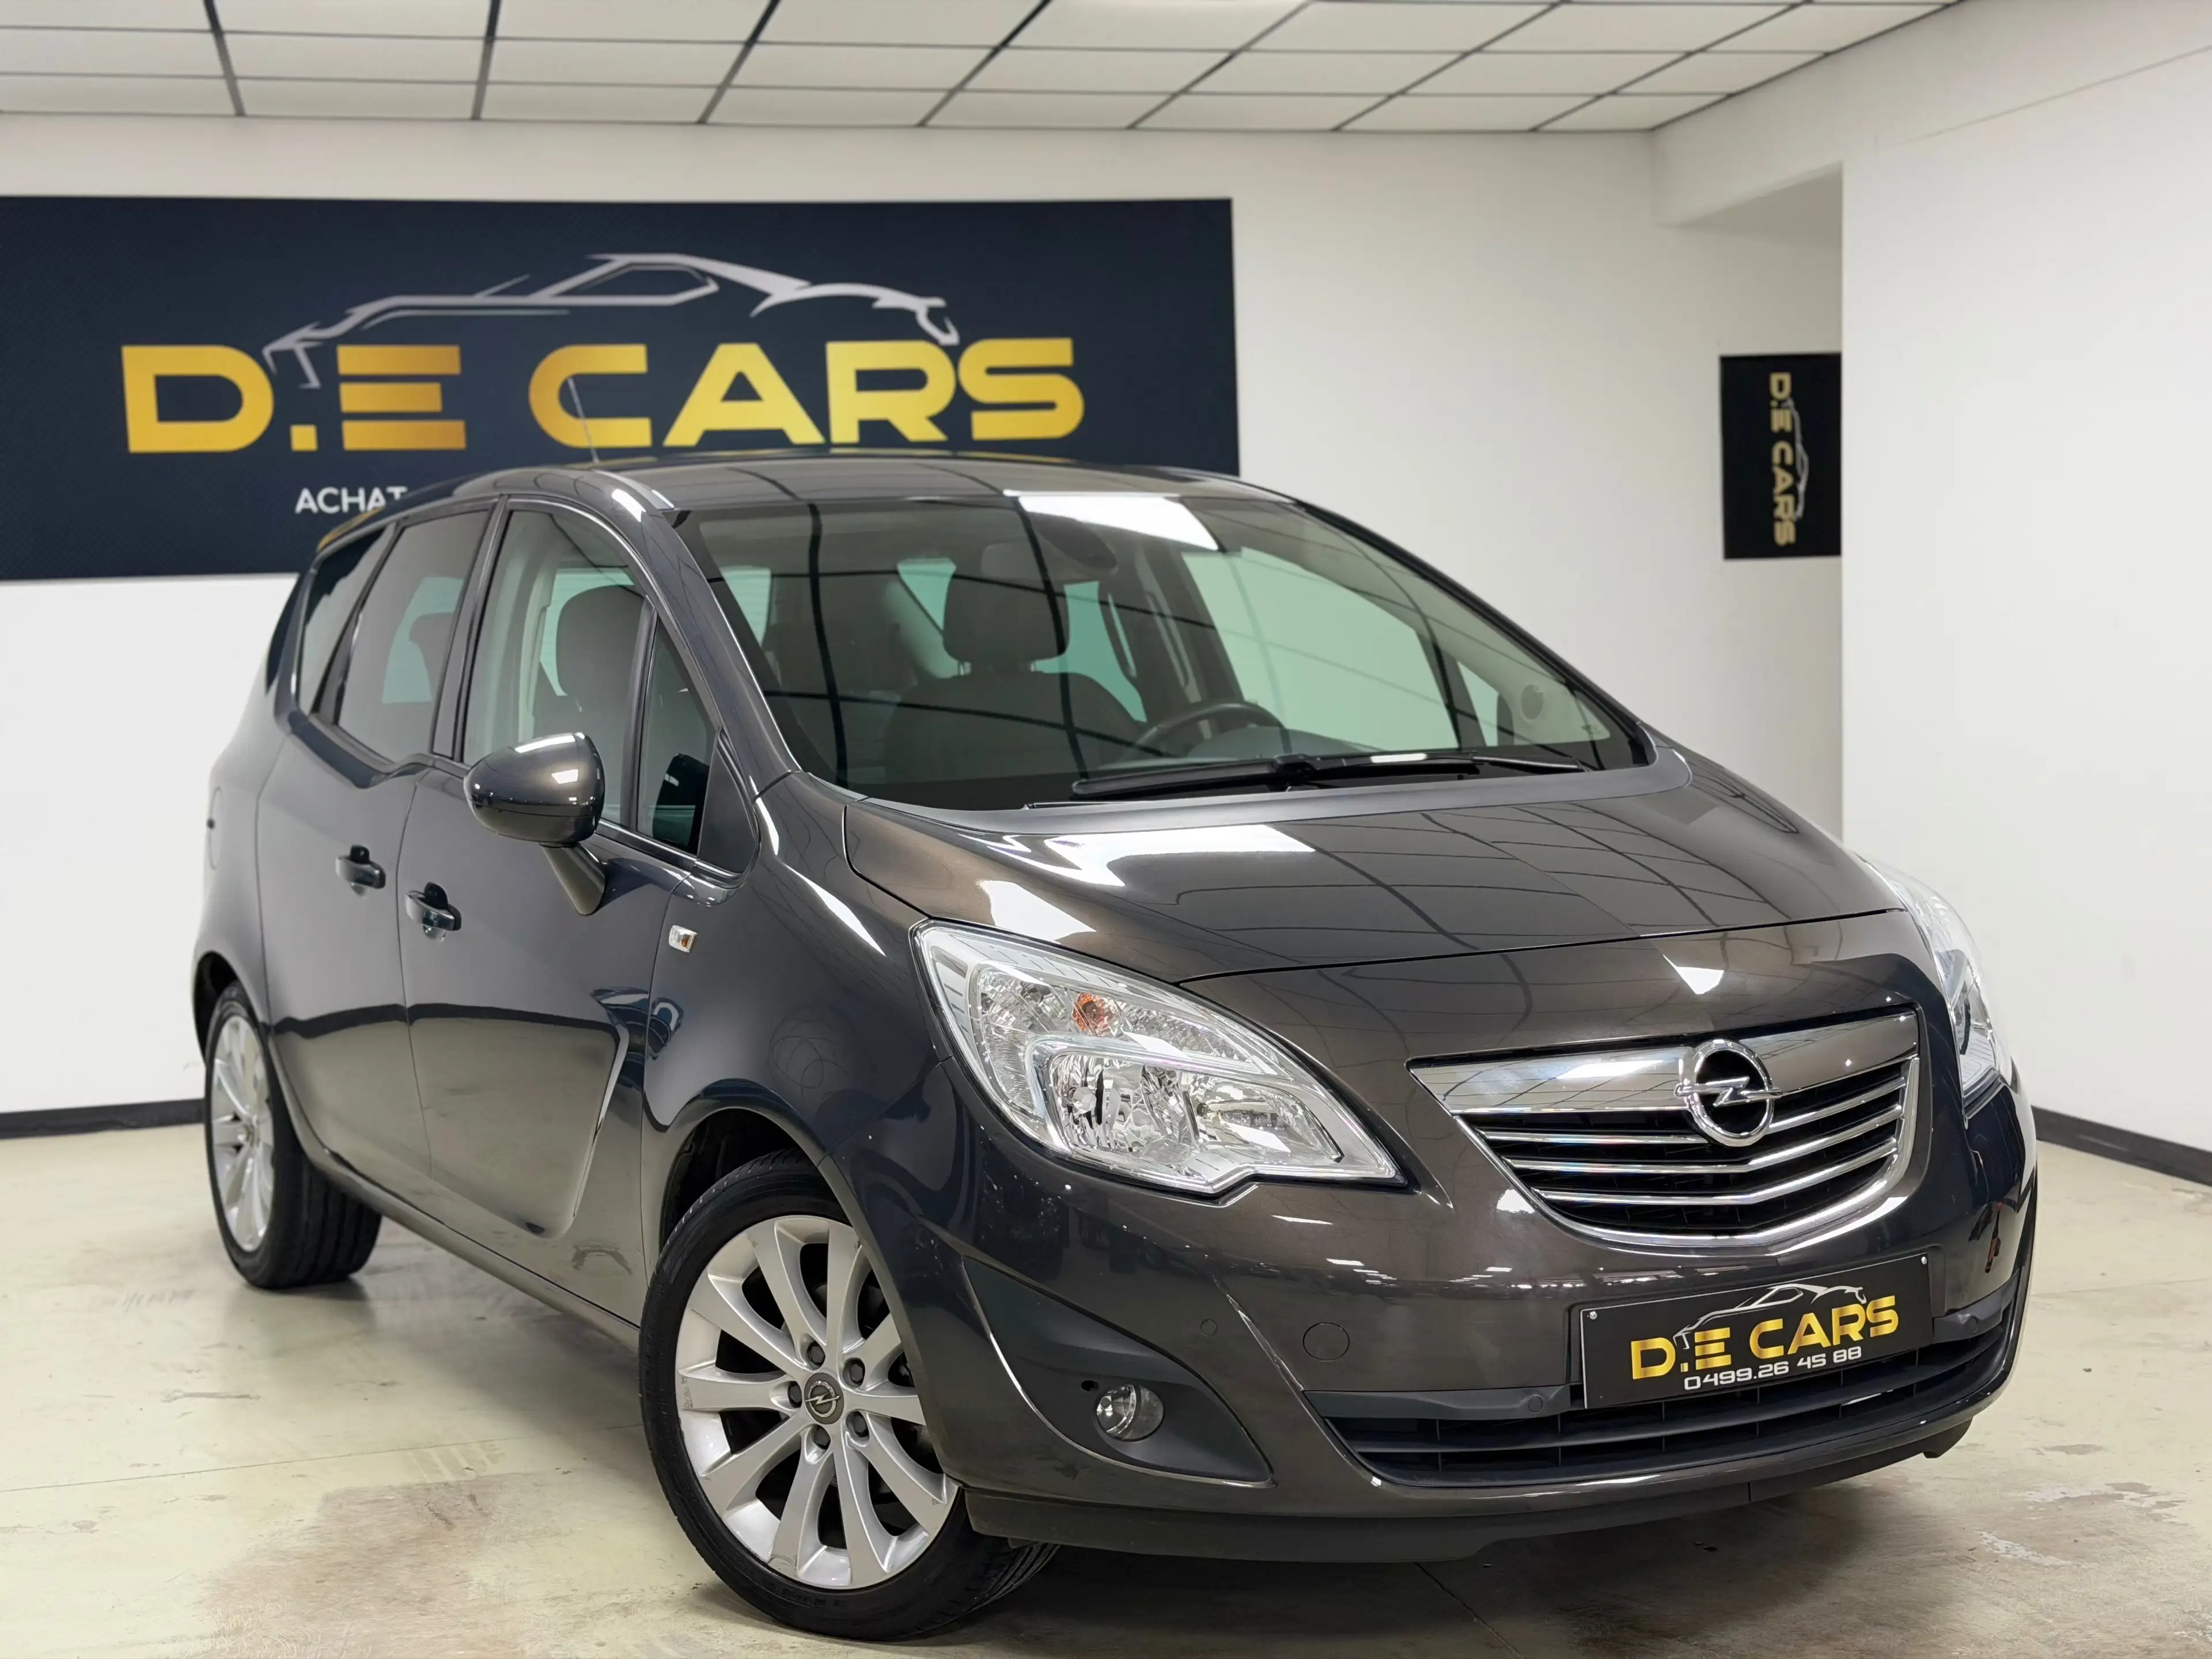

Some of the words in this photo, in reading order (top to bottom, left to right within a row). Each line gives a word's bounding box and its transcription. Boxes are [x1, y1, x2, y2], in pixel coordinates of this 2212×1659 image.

[121, 344, 467, 454] D.E
[529, 338, 1085, 449] CARS
[1769, 372, 1793, 433] D.E
[294, 486, 408, 514] ACHAT
[1771, 440, 1797, 547] CARS
[1630, 1327, 1732, 1380] D.E
[1748, 1295, 1899, 1359] CARS
[1684, 1361, 1789, 1390] 0499.26
[1796, 1353, 1827, 1369] 45
[1832, 1346, 1862, 1363] 88
